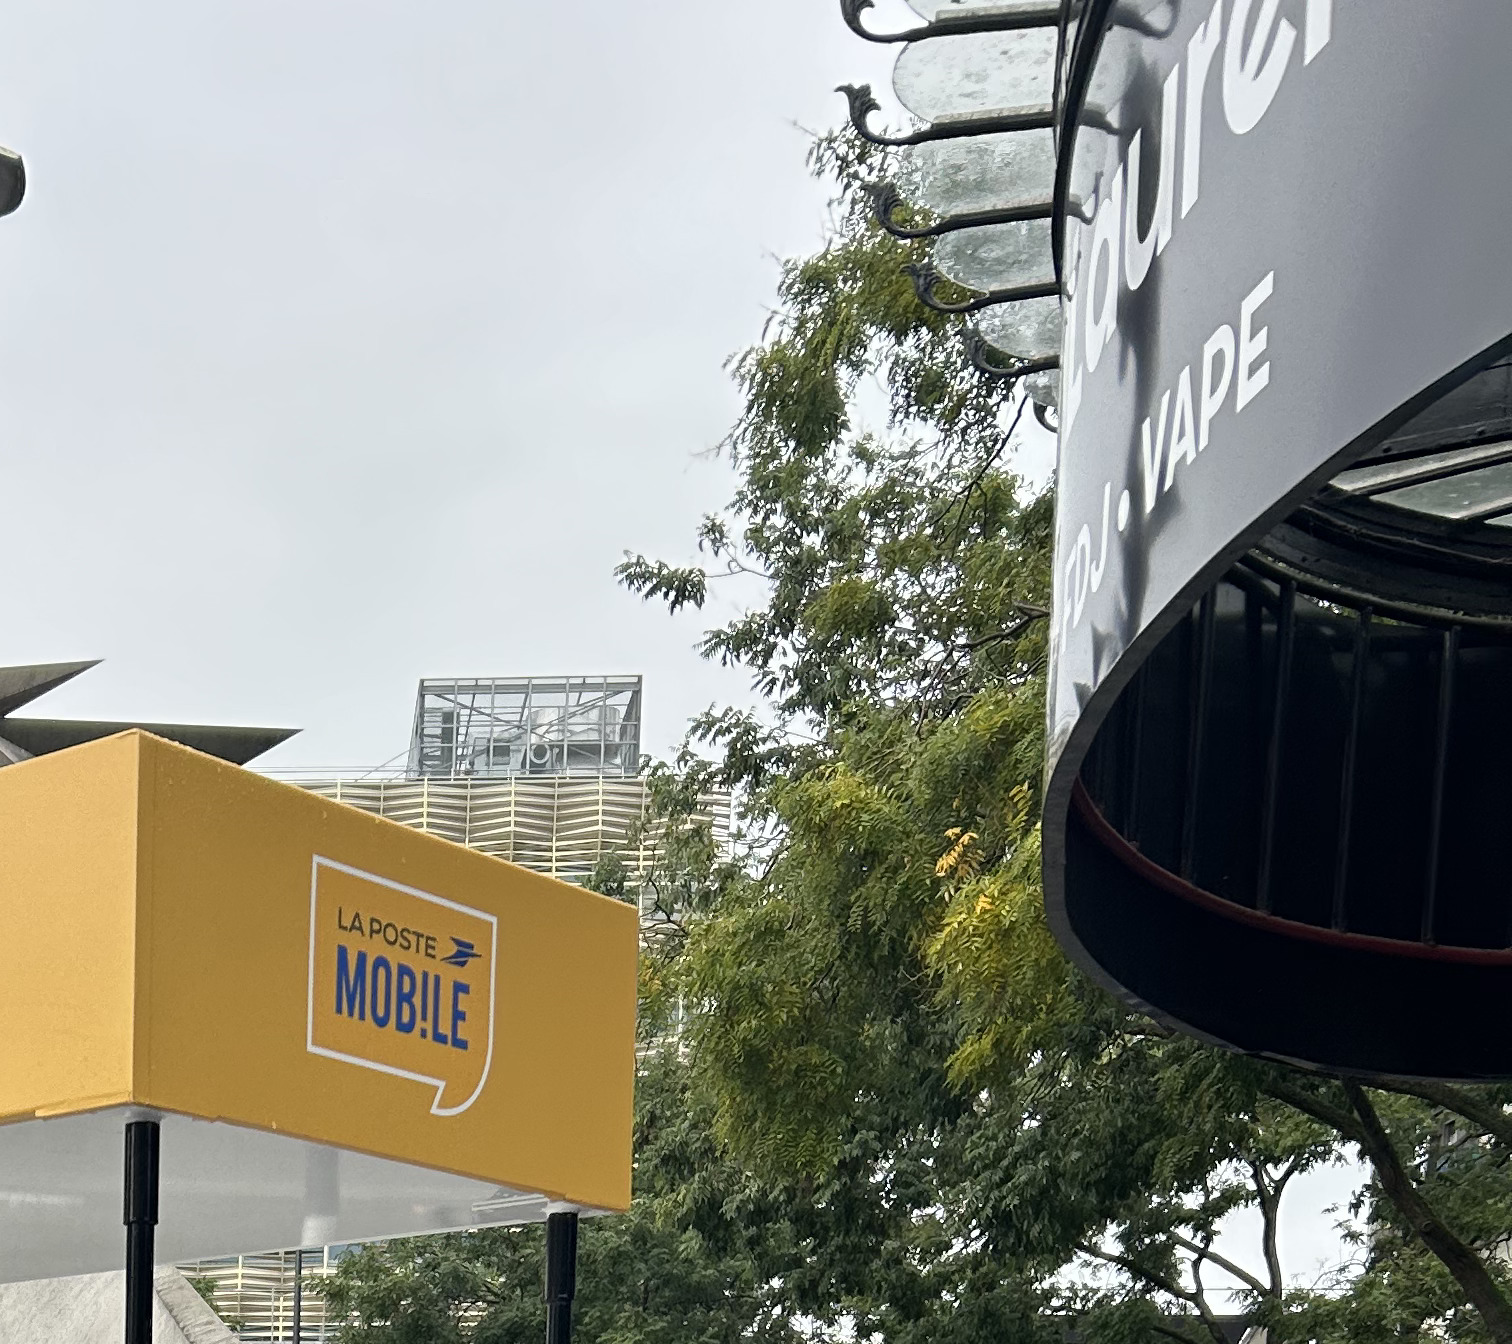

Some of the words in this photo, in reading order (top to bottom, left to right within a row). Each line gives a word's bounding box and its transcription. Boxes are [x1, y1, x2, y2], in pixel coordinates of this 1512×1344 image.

[1141, 270, 1275, 514] VAPE
[338, 906, 365, 936] LA
[369, 916, 437, 960] POSTE
